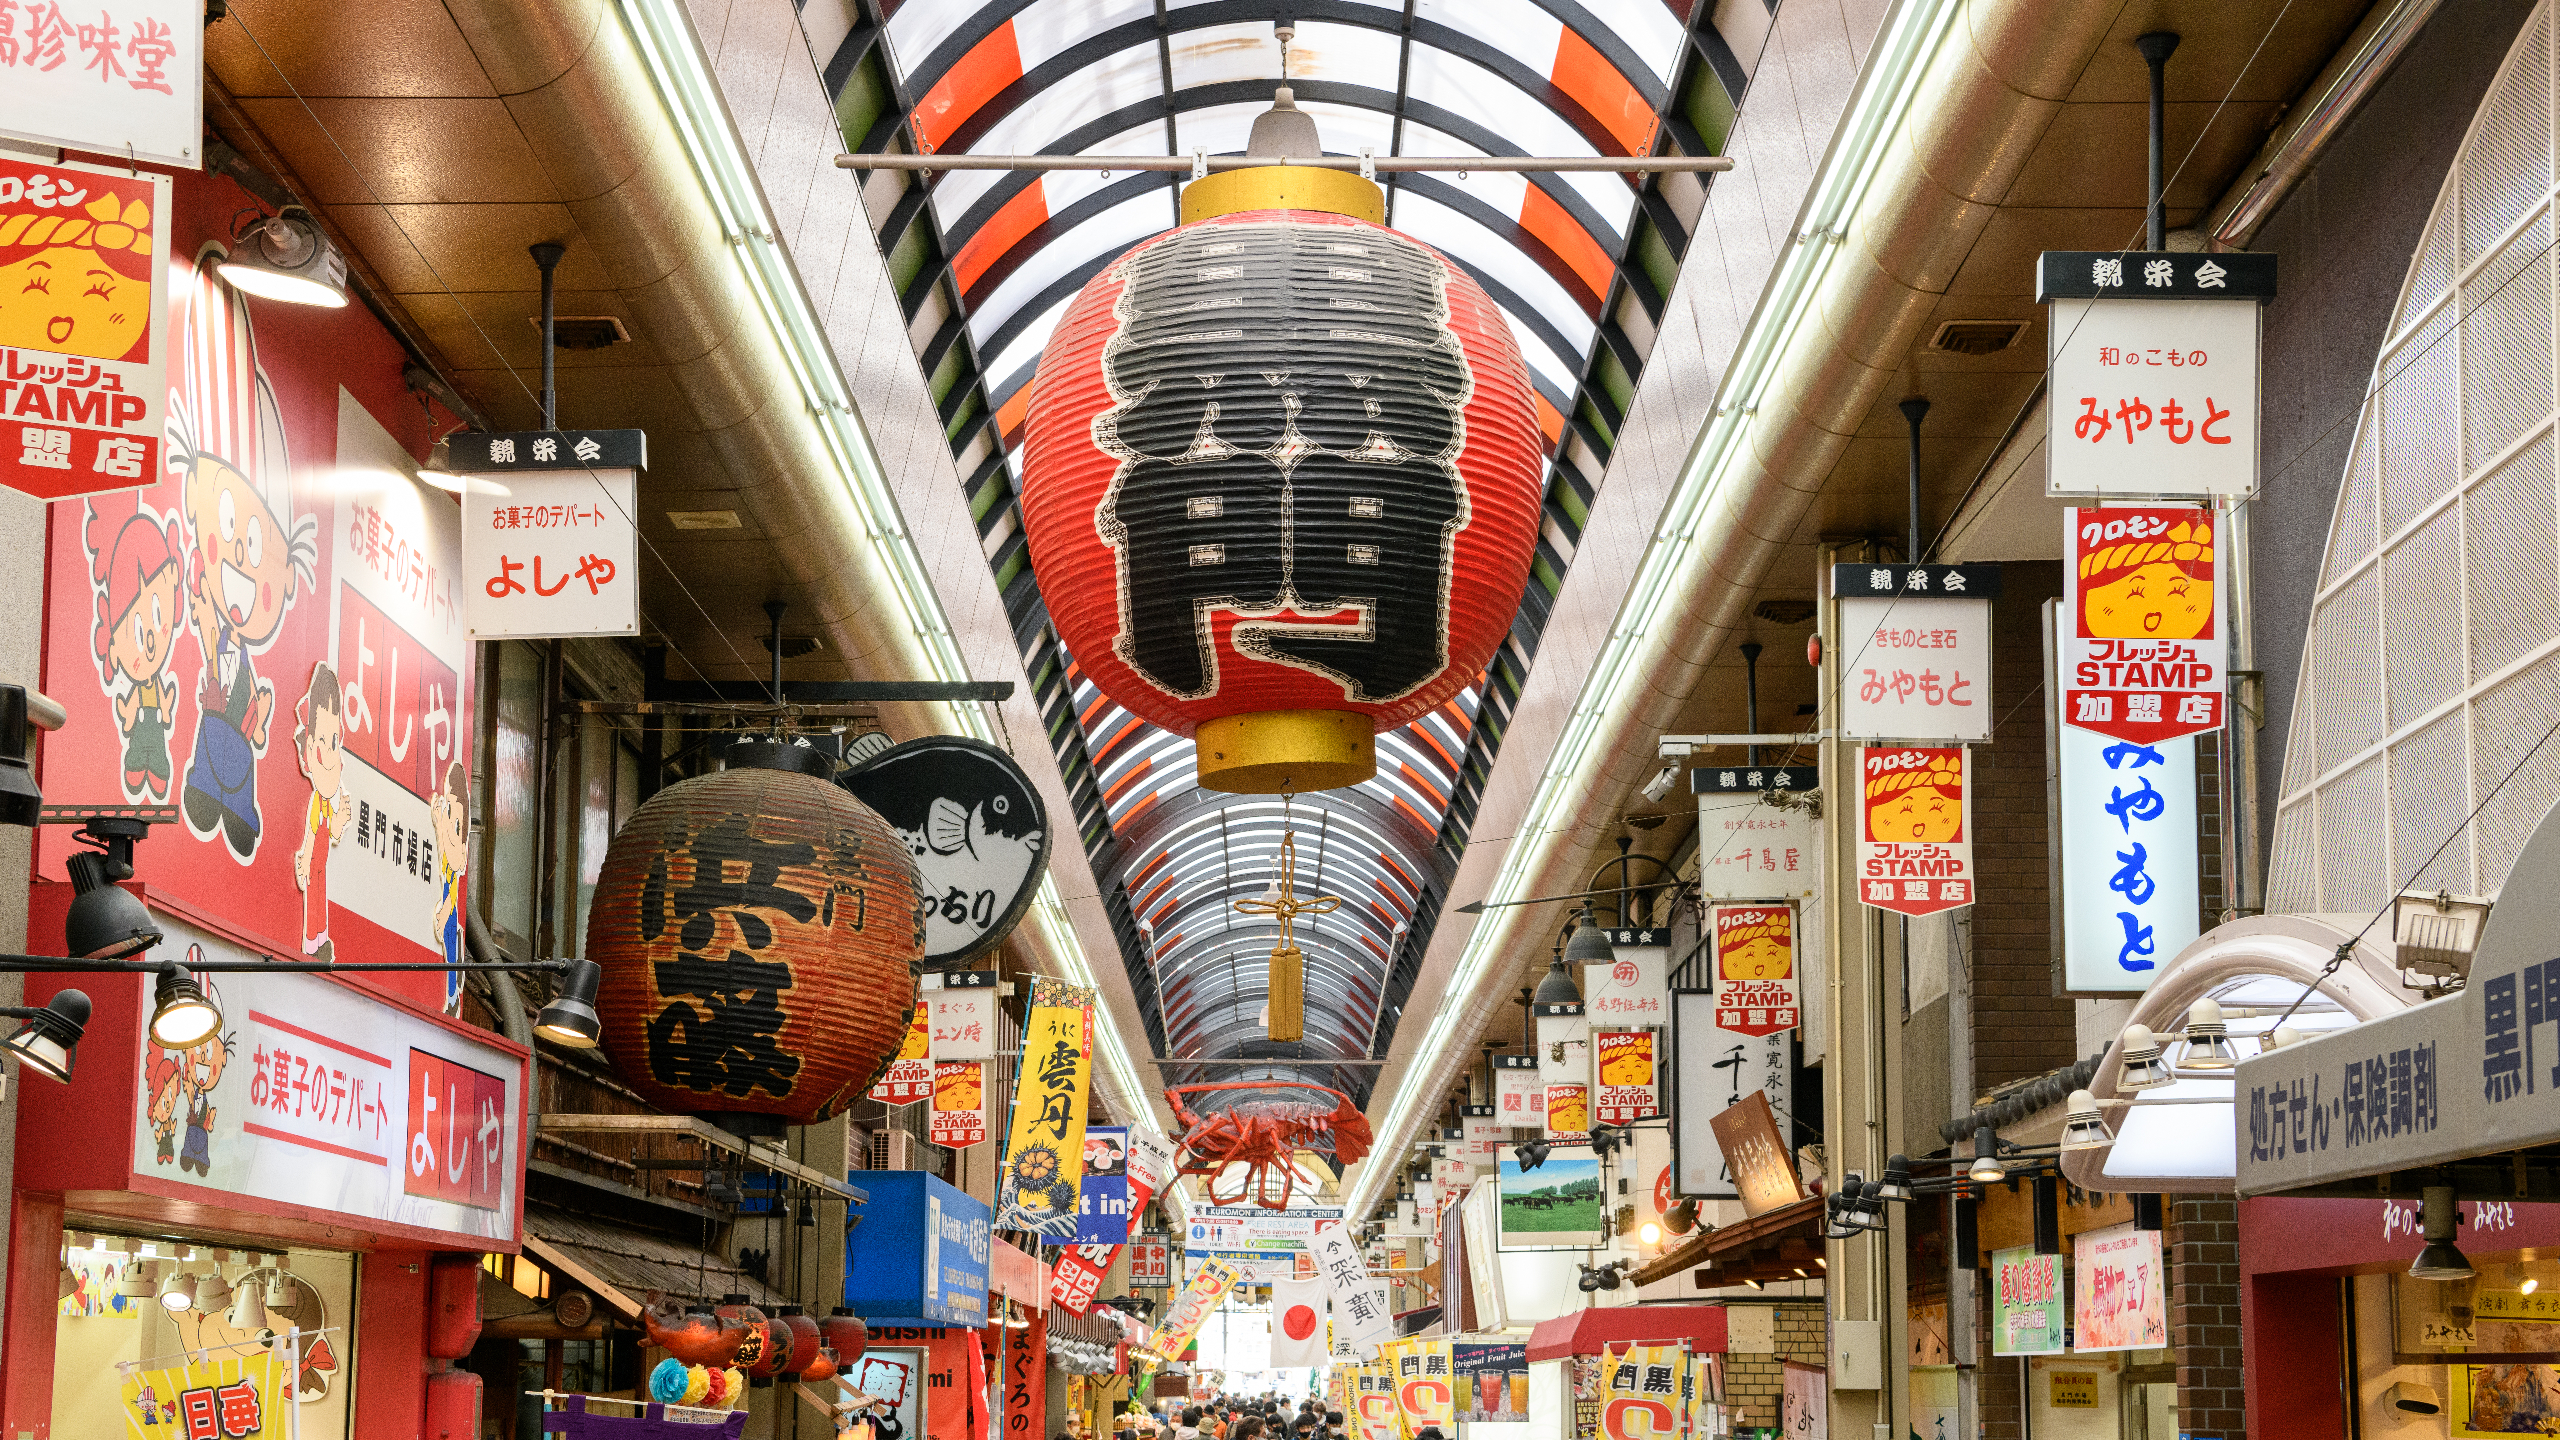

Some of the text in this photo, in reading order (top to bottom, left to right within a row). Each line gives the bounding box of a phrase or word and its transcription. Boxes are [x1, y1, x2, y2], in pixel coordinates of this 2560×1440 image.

[2092, 258, 2227, 288] 親栄会
[2099, 347, 2208, 367] 和のこもの
[0, 348, 124, 393] レッシュ
[2074, 396, 2232, 445] みやもと
[490, 437, 601, 463] 親栄会
[492, 503, 605, 530] お菓子のデパート
[2081, 515, 2169, 548] クロモン
[349, 501, 456, 636] お菓子のデパート
[485, 553, 616, 598] よしや
[1870, 569, 1966, 591] 親栄会
[1875, 628, 1957, 649] きものと宝石
[2088, 639, 2198, 662] フレッシュ
[2076, 662, 2213, 689] STAMP
[1860, 668, 1973, 707] みやもと
[343, 616, 453, 791] よしや
[2076, 693, 2213, 724] 加盟店
[1867, 751, 1929, 776] クロモン
[1719, 771, 1791, 787] 親栄会
[357, 798, 433, 885] 黒門市場店
[1874, 843, 1952, 859] フレッシュ
[1734, 847, 1800, 873] 千鳥屋
[2102, 742, 2165, 972] みやもと
[1866, 859, 1964, 877] STAMP
[1868, 881, 1965, 901] 加盟店
[1720, 911, 1766, 931] クロモン
[1726, 980, 1784, 992] フレッシュ
[938, 1002, 976, 1013] まぐろ
[1549, 1004, 1584, 1014] 親栄
[1720, 992, 1793, 1007] STAMP
[1721, 1008, 1793, 1026] 加盟店
[933, 1020, 984, 1043] エン時
[1048, 1021, 1076, 1038] うに
[1600, 1035, 1635, 1049] クロモン
[1507, 1057, 1537, 1067] 親栄
[250, 1042, 388, 1141] お菓子のデパート
[872, 1083, 930, 1097] 加盟店
[1548, 1088, 1579, 1100] クロモン
[1604, 1086, 1647, 1095] フレッシュ
[1600, 1095, 1653, 1106] STAMP
[2250, 1039, 2437, 1164] 処方せん・保険調剤
[933, 1118, 982, 1129] STAMP
[937, 1111, 976, 1119] フレッシュ
[1600, 1107, 1655, 1120] 加盟店
[411, 1070, 500, 1194] よしや
[933, 1129, 982, 1142] 加盟店
[1127, 1159, 1157, 1183] ax-Free
[1100, 1194, 1126, 1215] in
[1210, 1207, 1339, 1219] KUROMON INFORMATION CENTER
[1247, 1219, 1310, 1229] FREE REST AREA
[1257, 1240, 1280, 1249] Change
[1454, 1349, 1526, 1369] Original Fruit Juic
